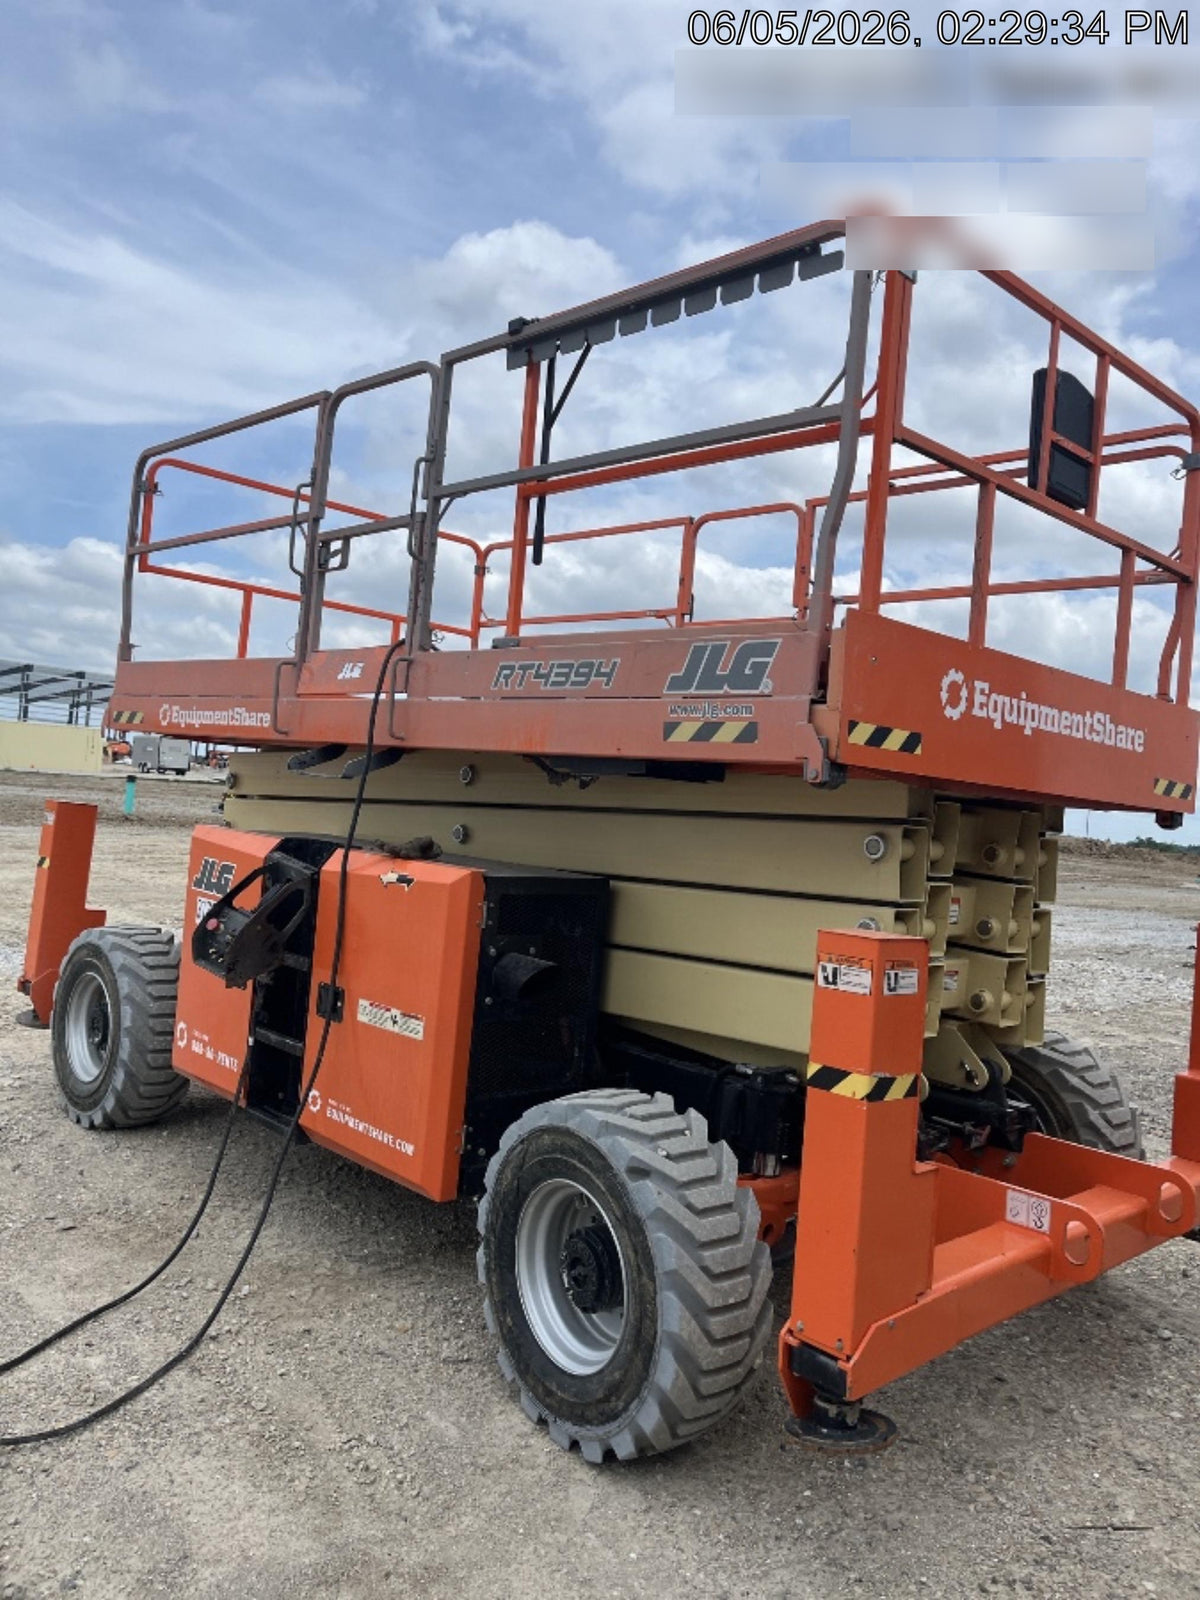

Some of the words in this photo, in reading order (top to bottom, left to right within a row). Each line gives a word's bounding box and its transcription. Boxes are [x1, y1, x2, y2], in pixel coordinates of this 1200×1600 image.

[491, 658, 621, 690] RT4394
[663, 638, 782, 694] JLG
[171, 705, 271, 728] EquipmentShare
[668, 702, 754, 719] www.jlg.com
[971, 680, 1145, 753] EquipmentShare
[192, 857, 236, 897] JLG
